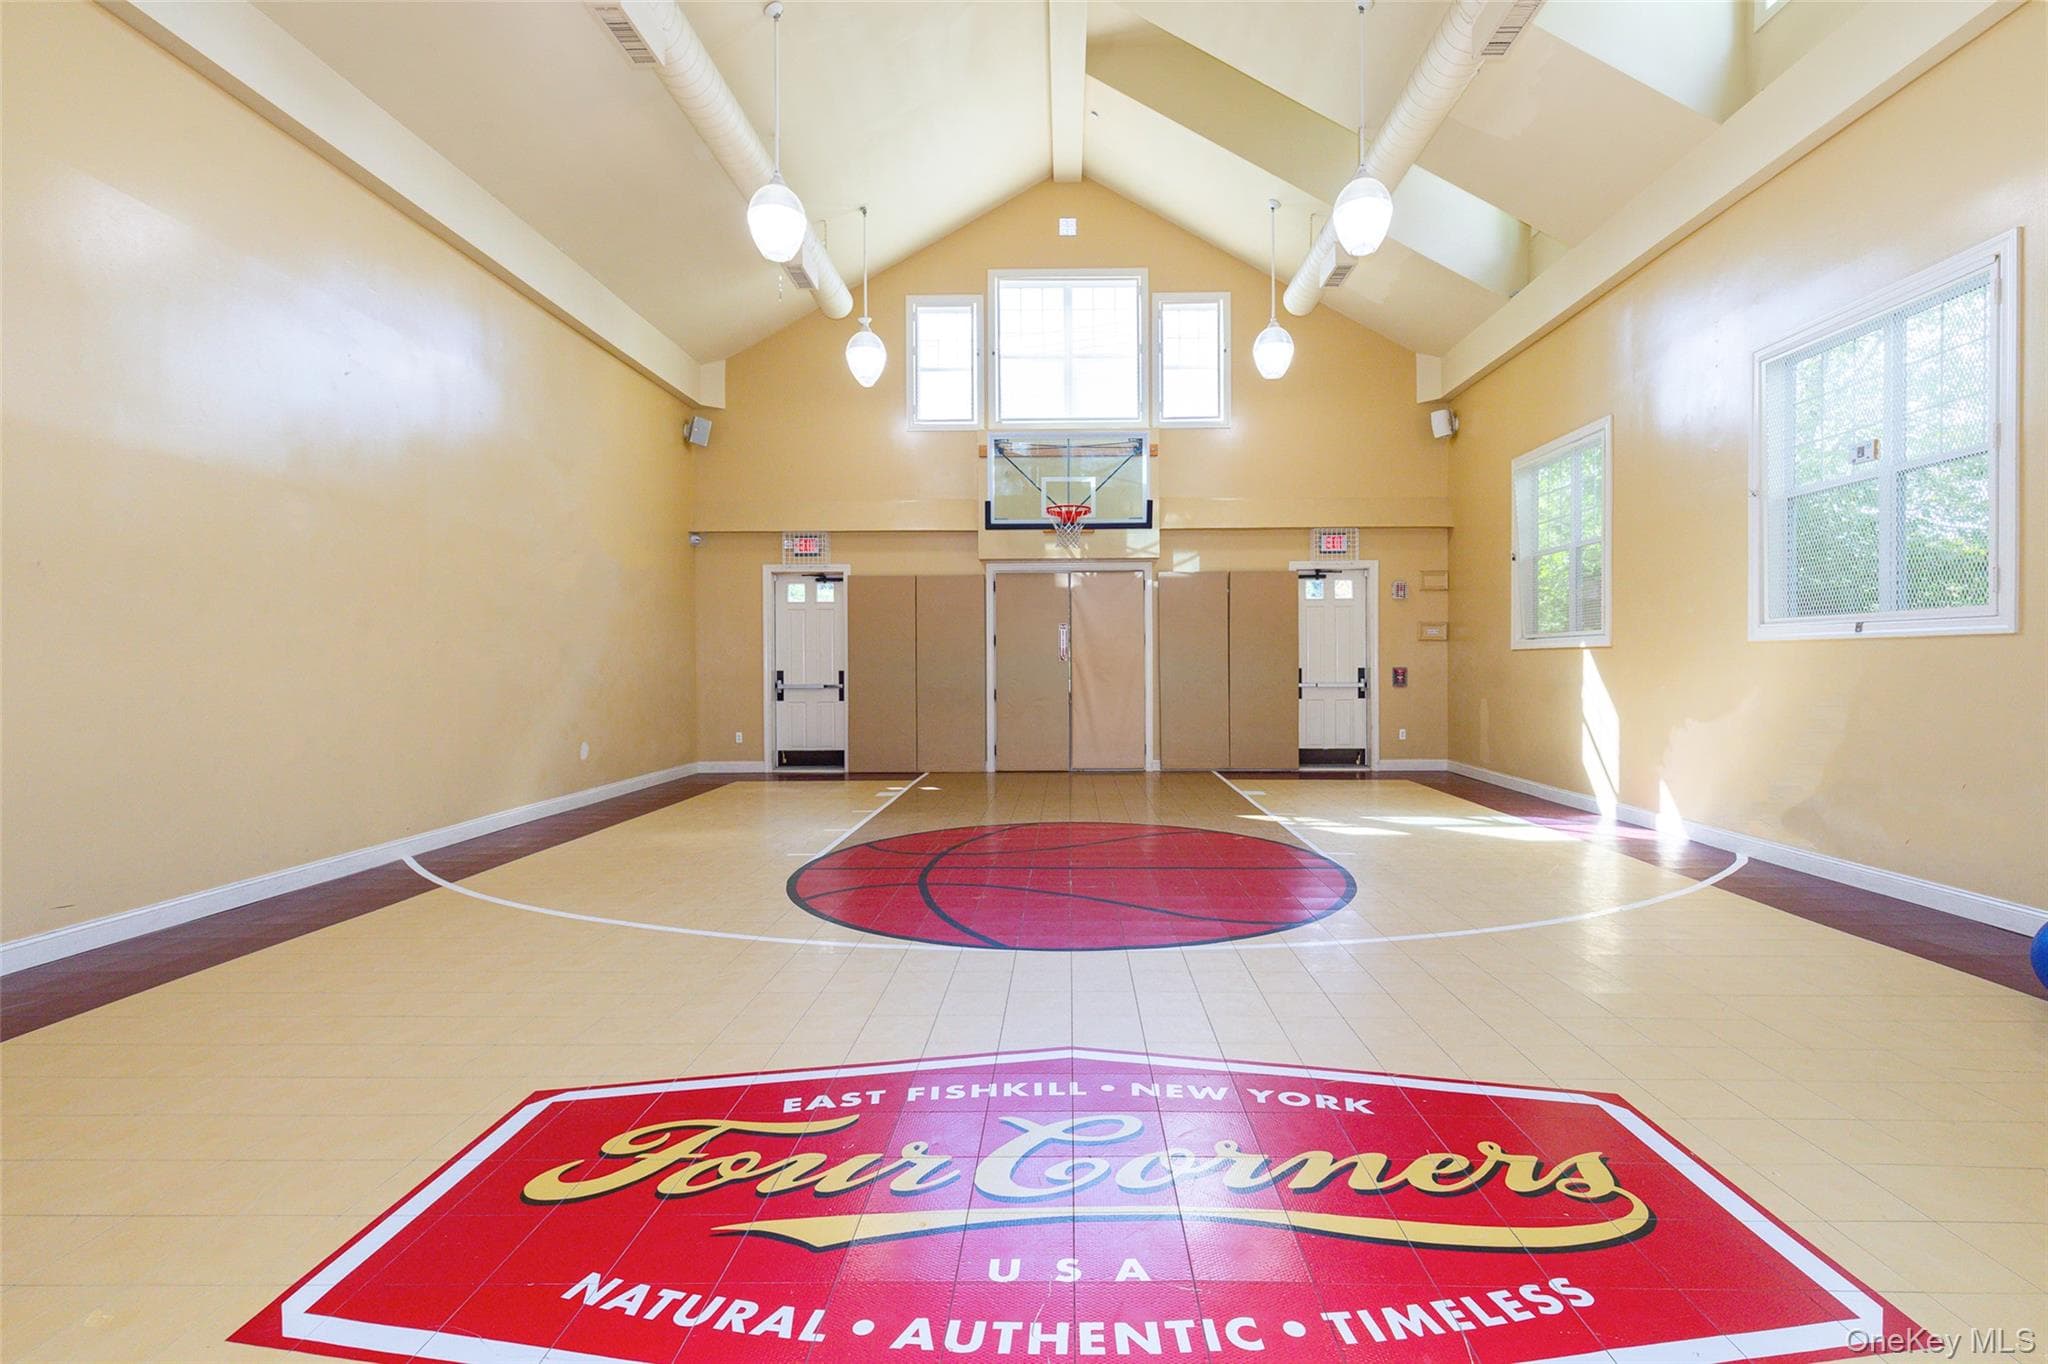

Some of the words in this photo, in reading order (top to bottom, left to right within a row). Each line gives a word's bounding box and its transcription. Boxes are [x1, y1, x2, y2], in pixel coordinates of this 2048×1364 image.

[783, 1089, 886, 1113] EAST
[907, 1081, 1087, 1102] FISHKILL
[1130, 1082, 1228, 1104] NEW
[1246, 1087, 1375, 1115] YORK
[520, 1114, 960, 1205] Four
[974, 1114, 1620, 1204] Corners
[561, 1271, 827, 1342] NATURAL
[1320, 1277, 1596, 1346] TIMELESS
[889, 1316, 1264, 1356] AUTHENTIC
